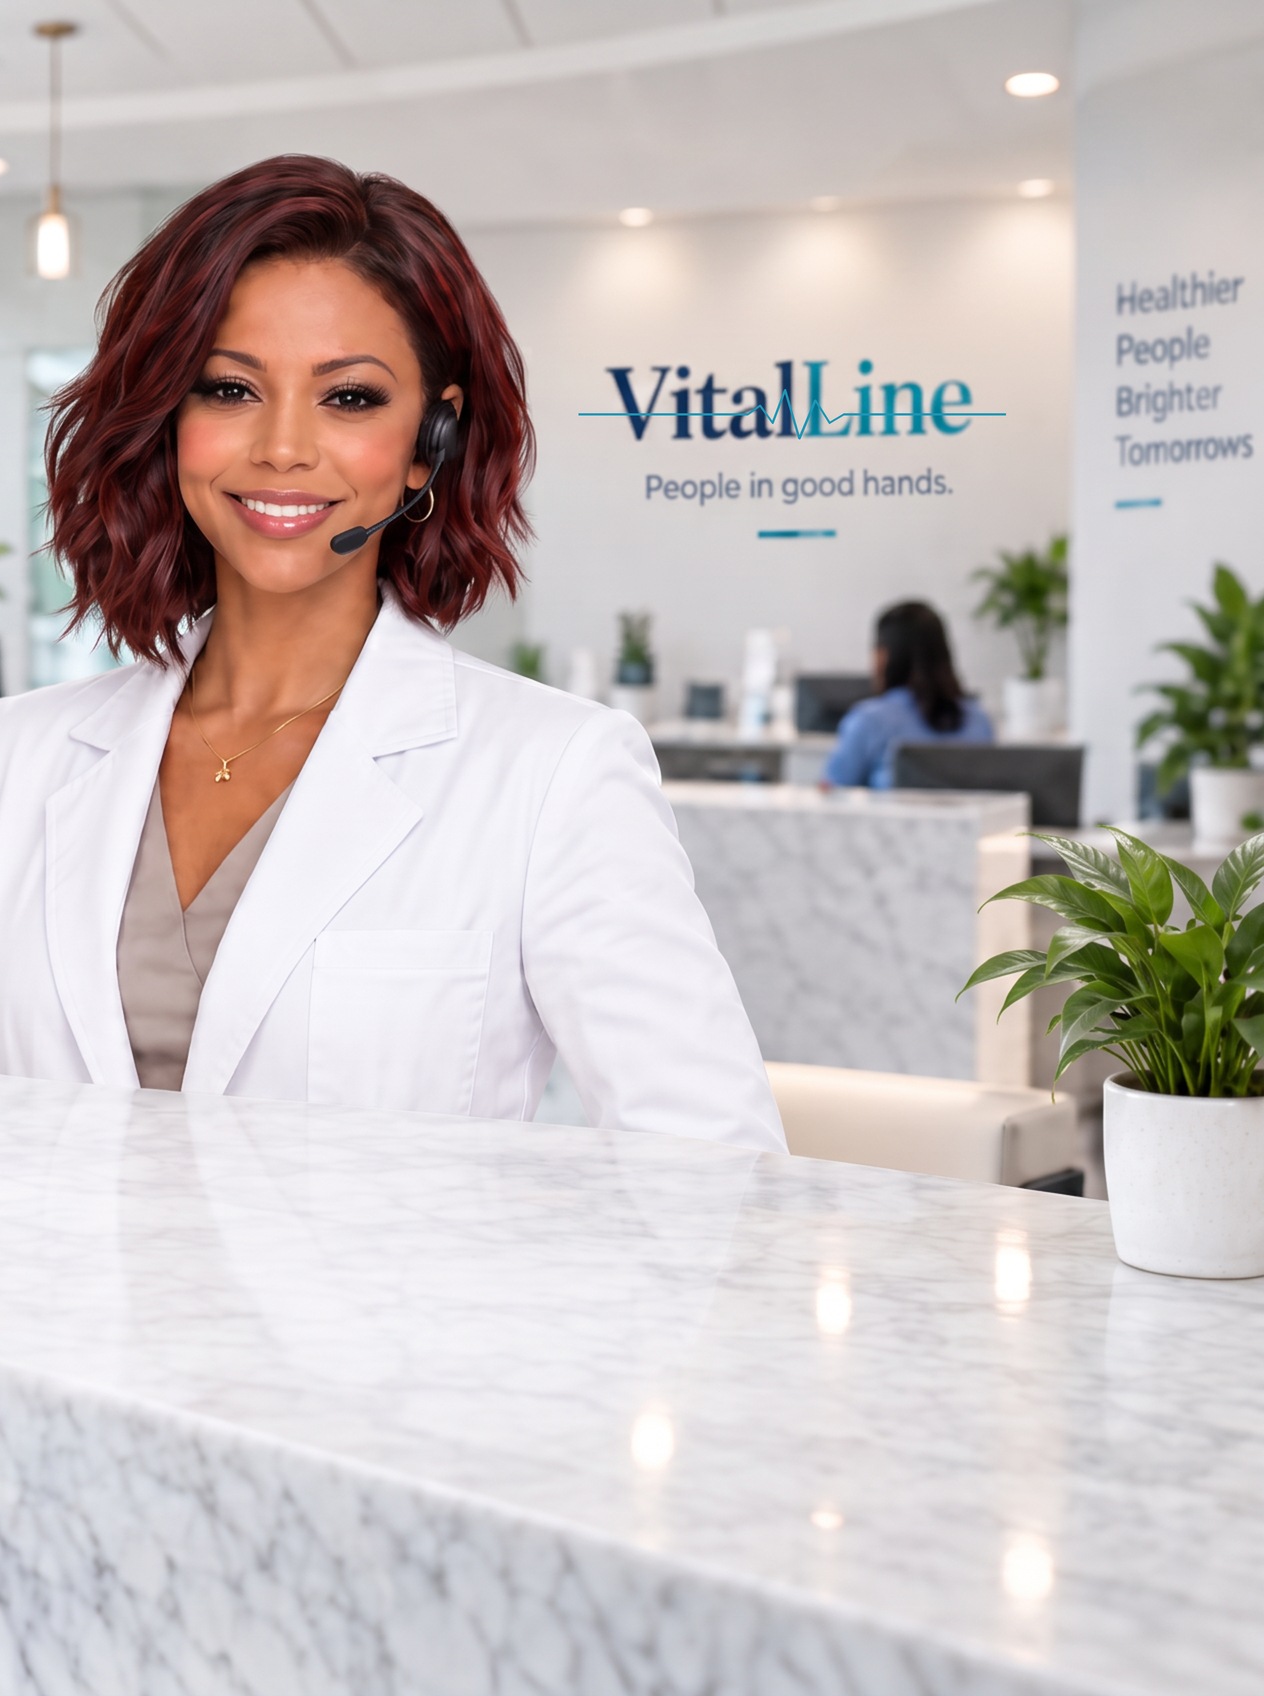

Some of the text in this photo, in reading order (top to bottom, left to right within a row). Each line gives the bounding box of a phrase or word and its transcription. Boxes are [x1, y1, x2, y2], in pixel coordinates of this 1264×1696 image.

[1115, 270, 1245, 316] Healthier
[1115, 326, 1211, 369] People
[605, 358, 973, 441] VitalLine
[1115, 381, 1222, 424] Brighter
[1115, 433, 1254, 467] Tomorrows
[645, 466, 954, 507] People in good hands.
